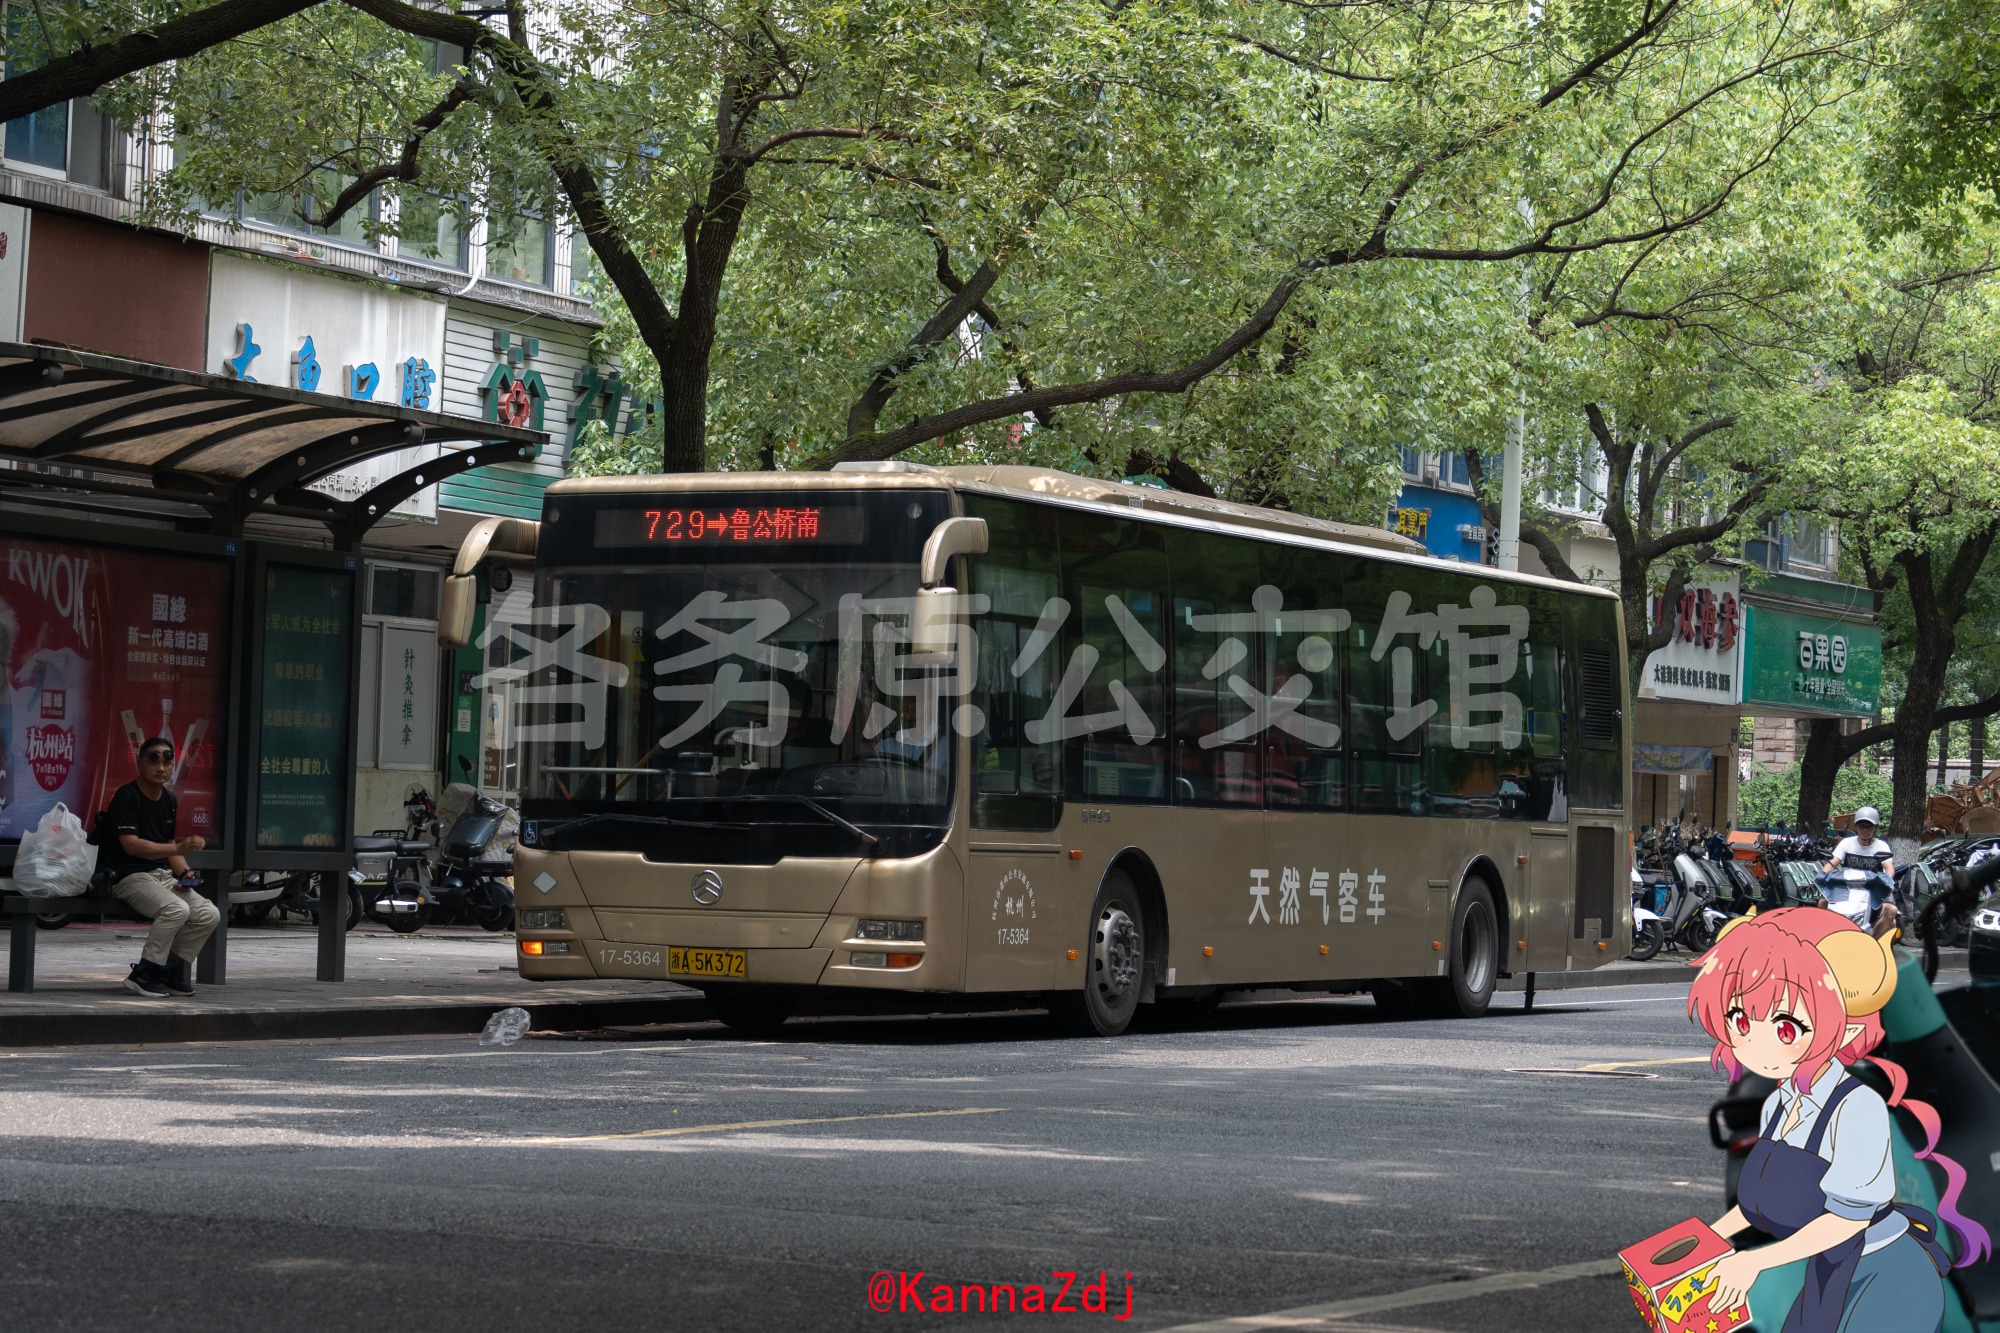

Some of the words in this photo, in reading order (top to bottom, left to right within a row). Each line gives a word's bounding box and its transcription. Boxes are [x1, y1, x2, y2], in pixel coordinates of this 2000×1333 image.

[645, 510, 705, 540] 729
[728, 507, 820, 540] 鲁公桥南
[8, 549, 90, 649] KWOK
[152, 593, 187, 623] 國緣
[1653, 587, 1739, 652] 双海参
[128, 626, 209, 652] 新一代高端白酒
[1797, 631, 1847, 674] 百果园
[402, 648, 415, 746] 针灸推拿
[28, 727, 74, 762] 杭州站
[36, 764, 67, 775] 7月18至19日
[261, 756, 331, 775] 全社会尊重的人
[1004, 894, 1025, 919] 杭州
[1248, 866, 1387, 926] 天然气客车
[997, 928, 1029, 945] 17-5364
[599, 949, 661, 966] 17-5364
